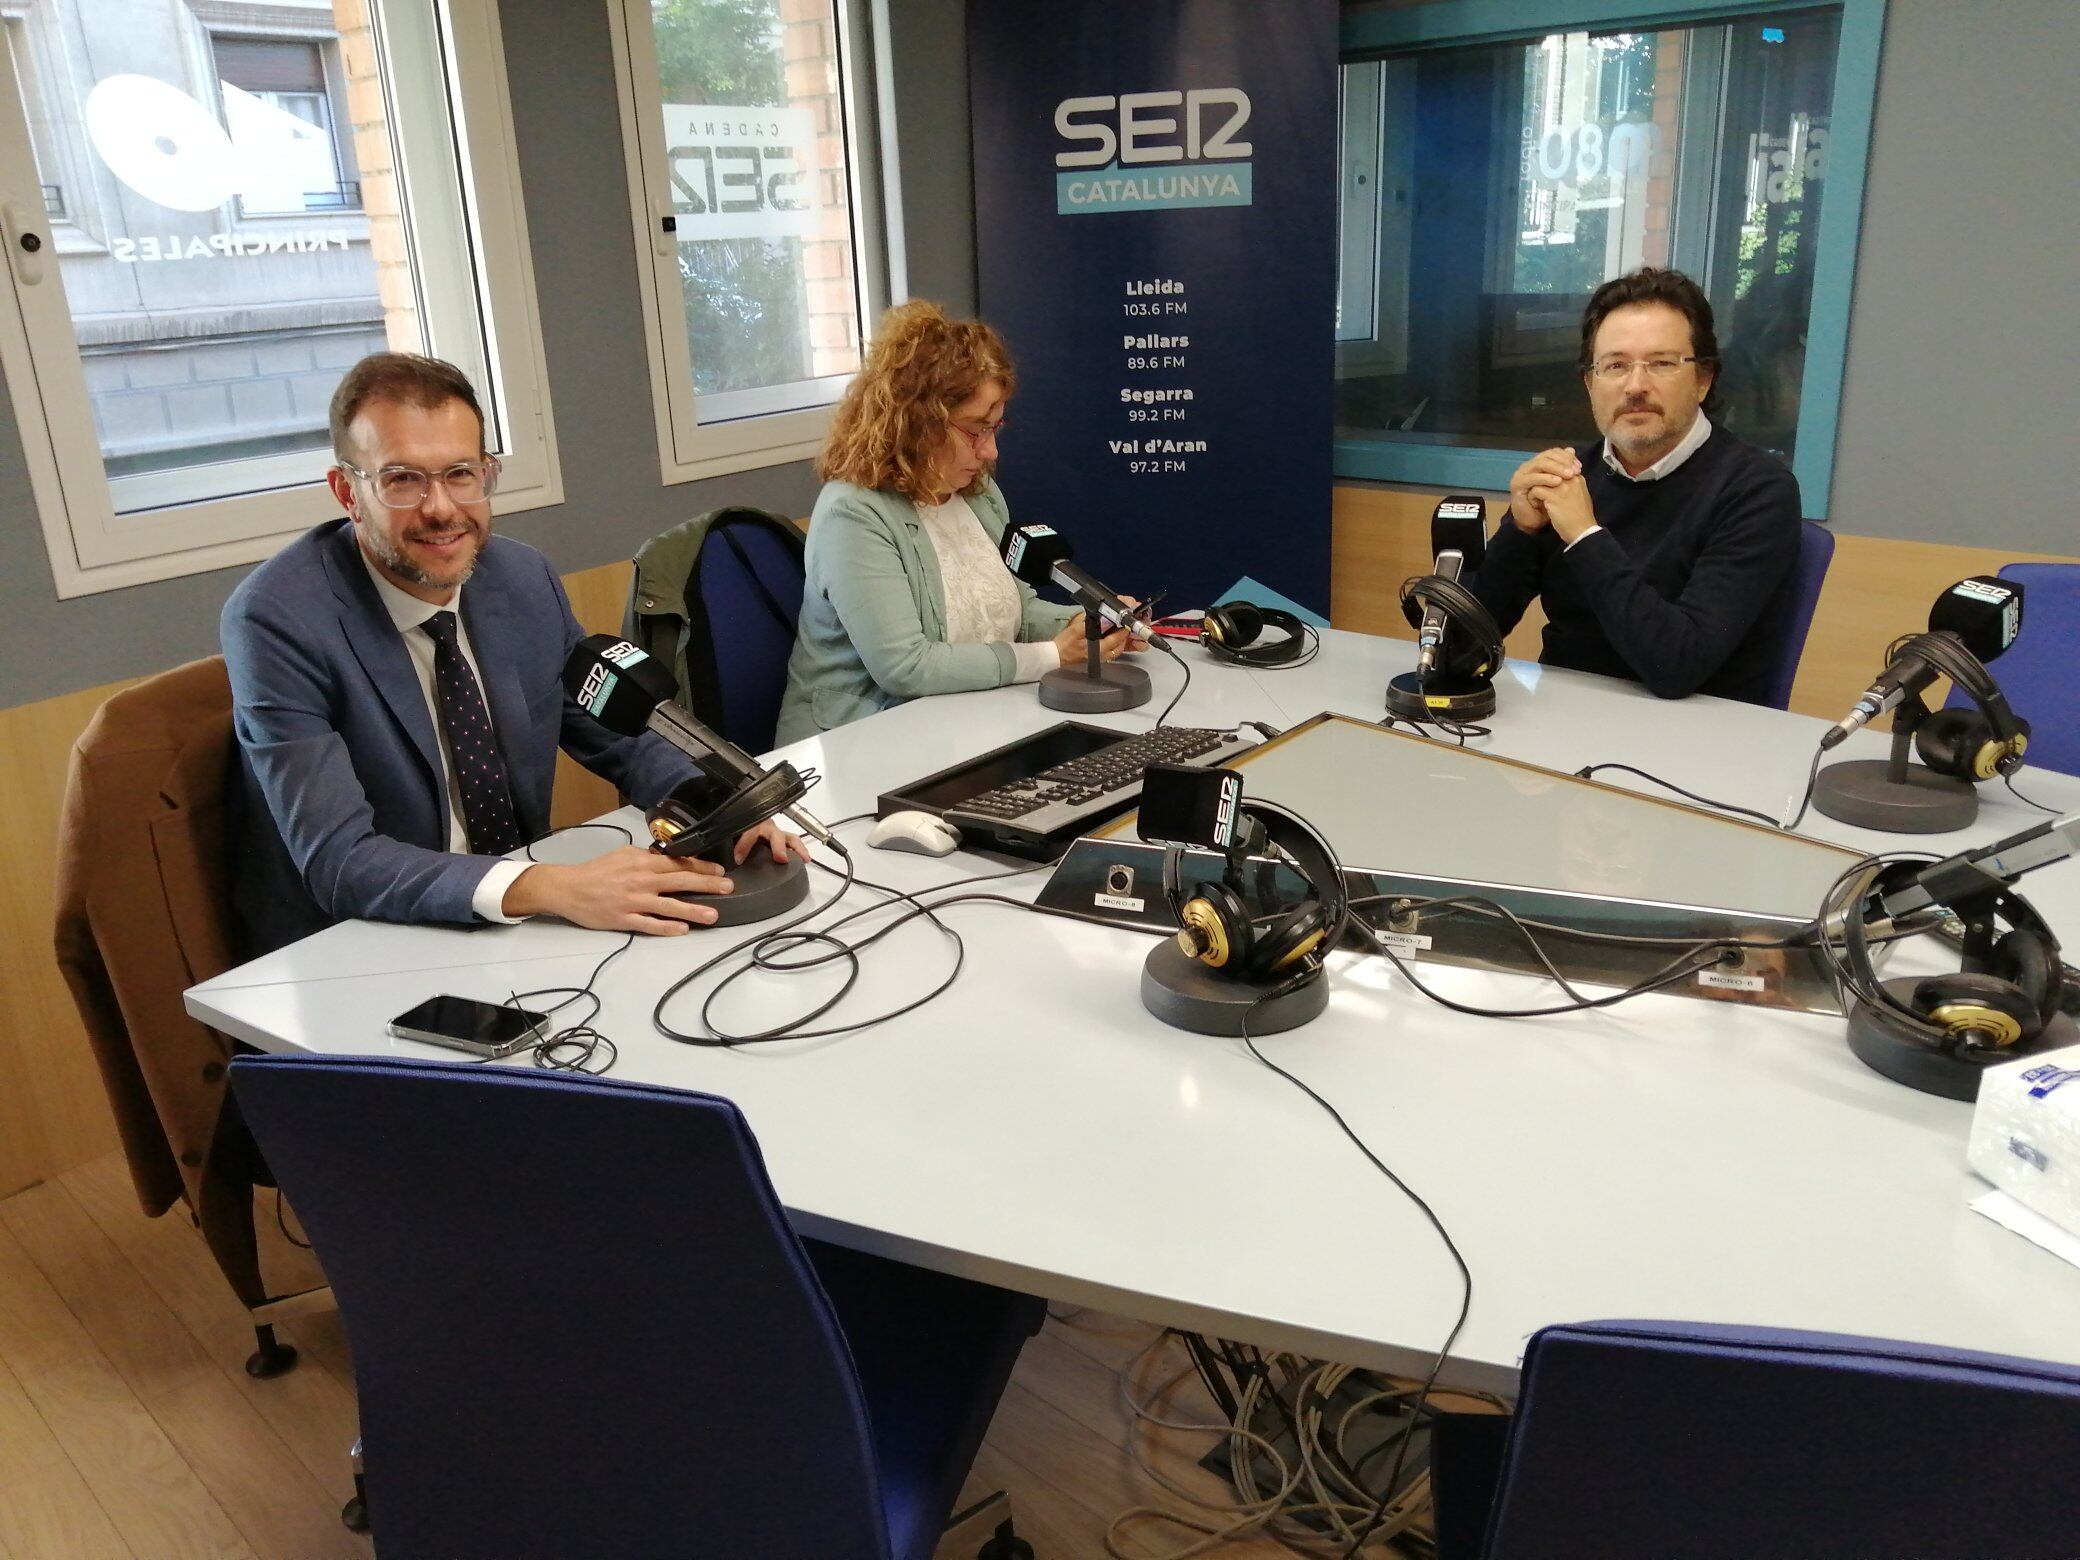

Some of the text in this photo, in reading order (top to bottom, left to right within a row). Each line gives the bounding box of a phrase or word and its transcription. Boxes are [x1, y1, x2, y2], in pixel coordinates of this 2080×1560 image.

[1054, 87, 1253, 167] SER
[1068, 174, 1240, 204] CATALUNYA
[1126, 278, 1185, 296] Lleida
[1123, 302, 1188, 316] 103.6 FM
[1123, 334, 1190, 350] Pallars
[1127, 356, 1185, 370] 89.6 FM
[1120, 388, 1194, 405] Segarra
[1128, 408, 1185, 421] 99.2 FM
[1108, 439, 1207, 454] Val d'Aran
[1130, 460, 1186, 473] 97.2 FM
[1439, 503, 1480, 513] SER
[1959, 580, 2012, 600] SER
[600, 641, 640, 663] SER
[577, 662, 609, 711] SER
[1213, 776, 1235, 847] SER
[1383, 935, 1422, 945] MICRO-7
